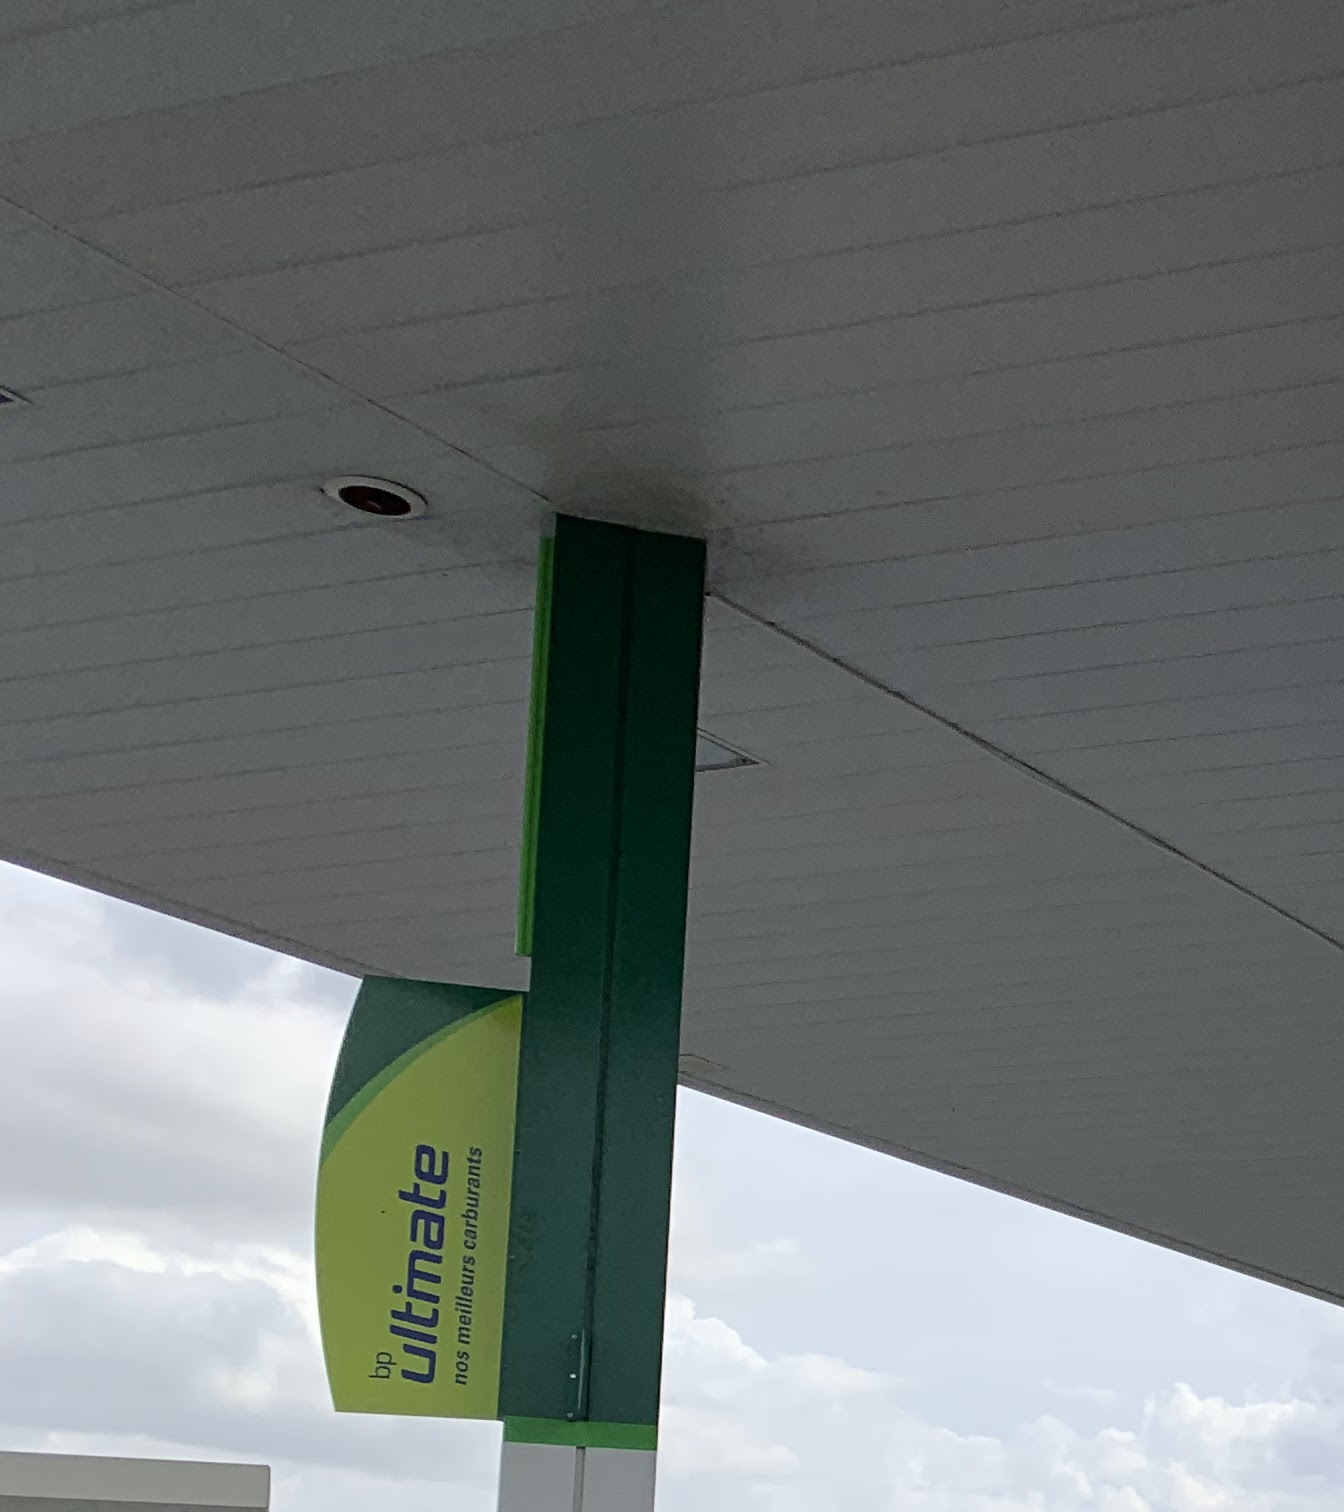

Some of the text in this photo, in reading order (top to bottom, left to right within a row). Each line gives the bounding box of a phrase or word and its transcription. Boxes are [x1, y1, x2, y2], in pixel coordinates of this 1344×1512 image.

[368, 1351, 398, 1380] bp
[388, 1143, 450, 1384] ultimate
[454, 1146, 483, 1386] nos meilleurs carburants
